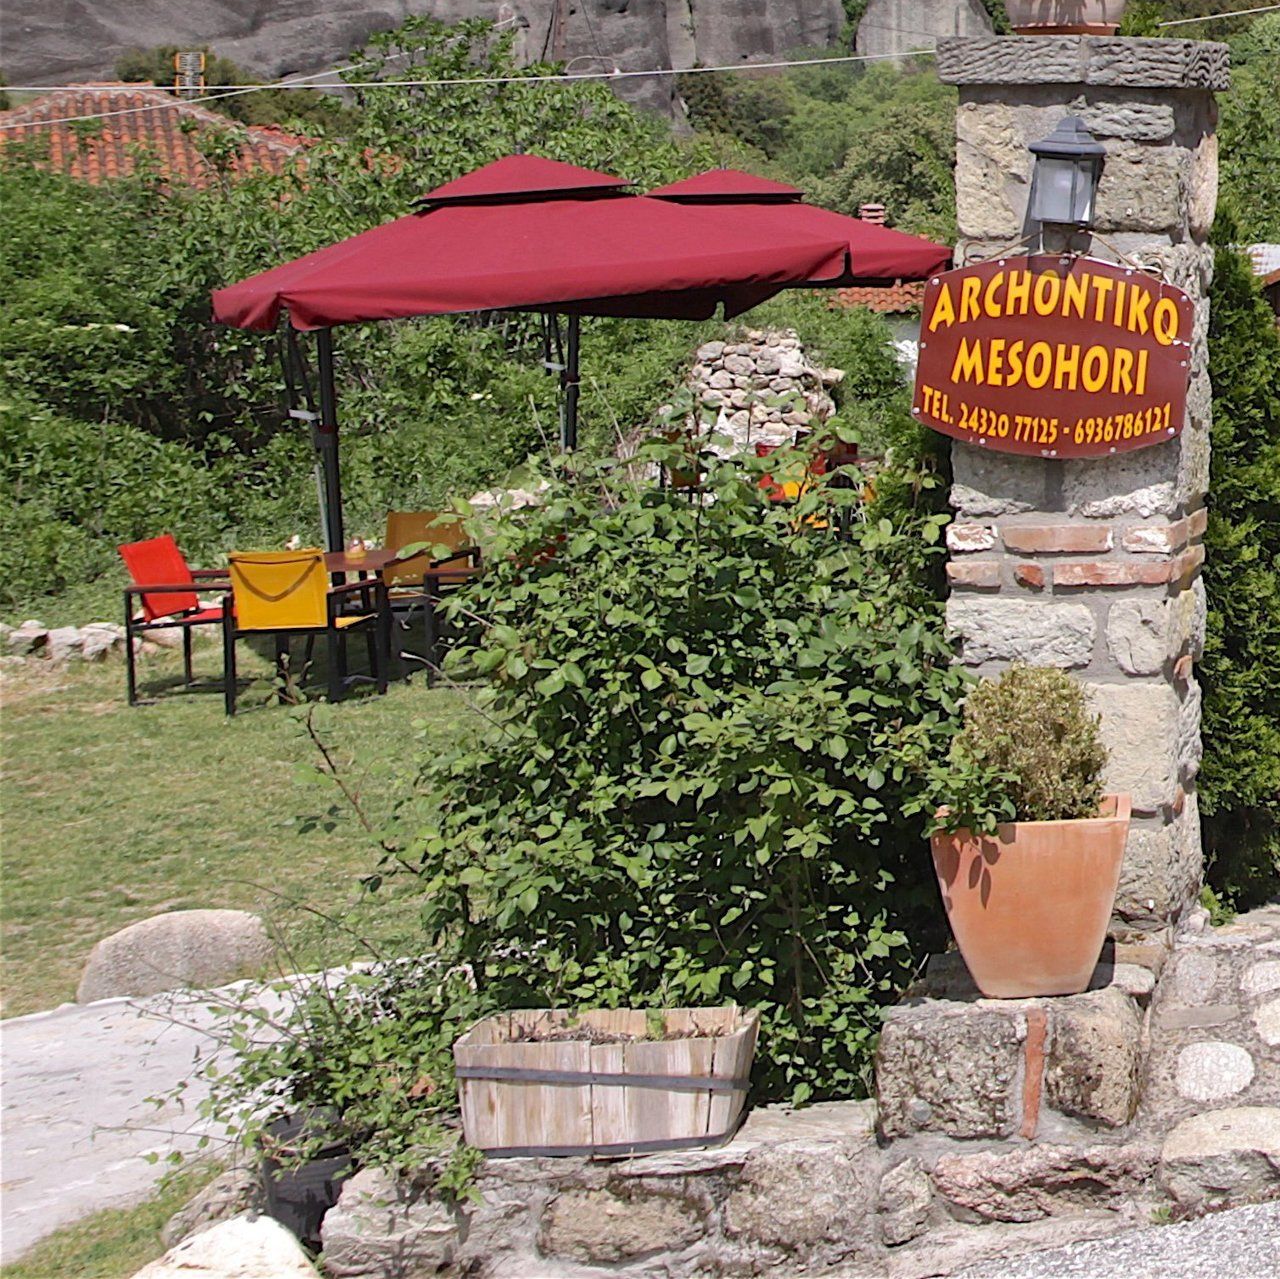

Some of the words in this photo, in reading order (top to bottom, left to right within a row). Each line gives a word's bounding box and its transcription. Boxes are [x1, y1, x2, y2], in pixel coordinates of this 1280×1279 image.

[928, 270, 1178, 346] ARCHONTIKO
[951, 337, 1148, 395] MESOHORI
[922, 384, 954, 424] TEL.
[958, 402, 1009, 438] 24320
[1014, 415, 1058, 444] 77125
[1074, 402, 1171, 444] 6936786121
